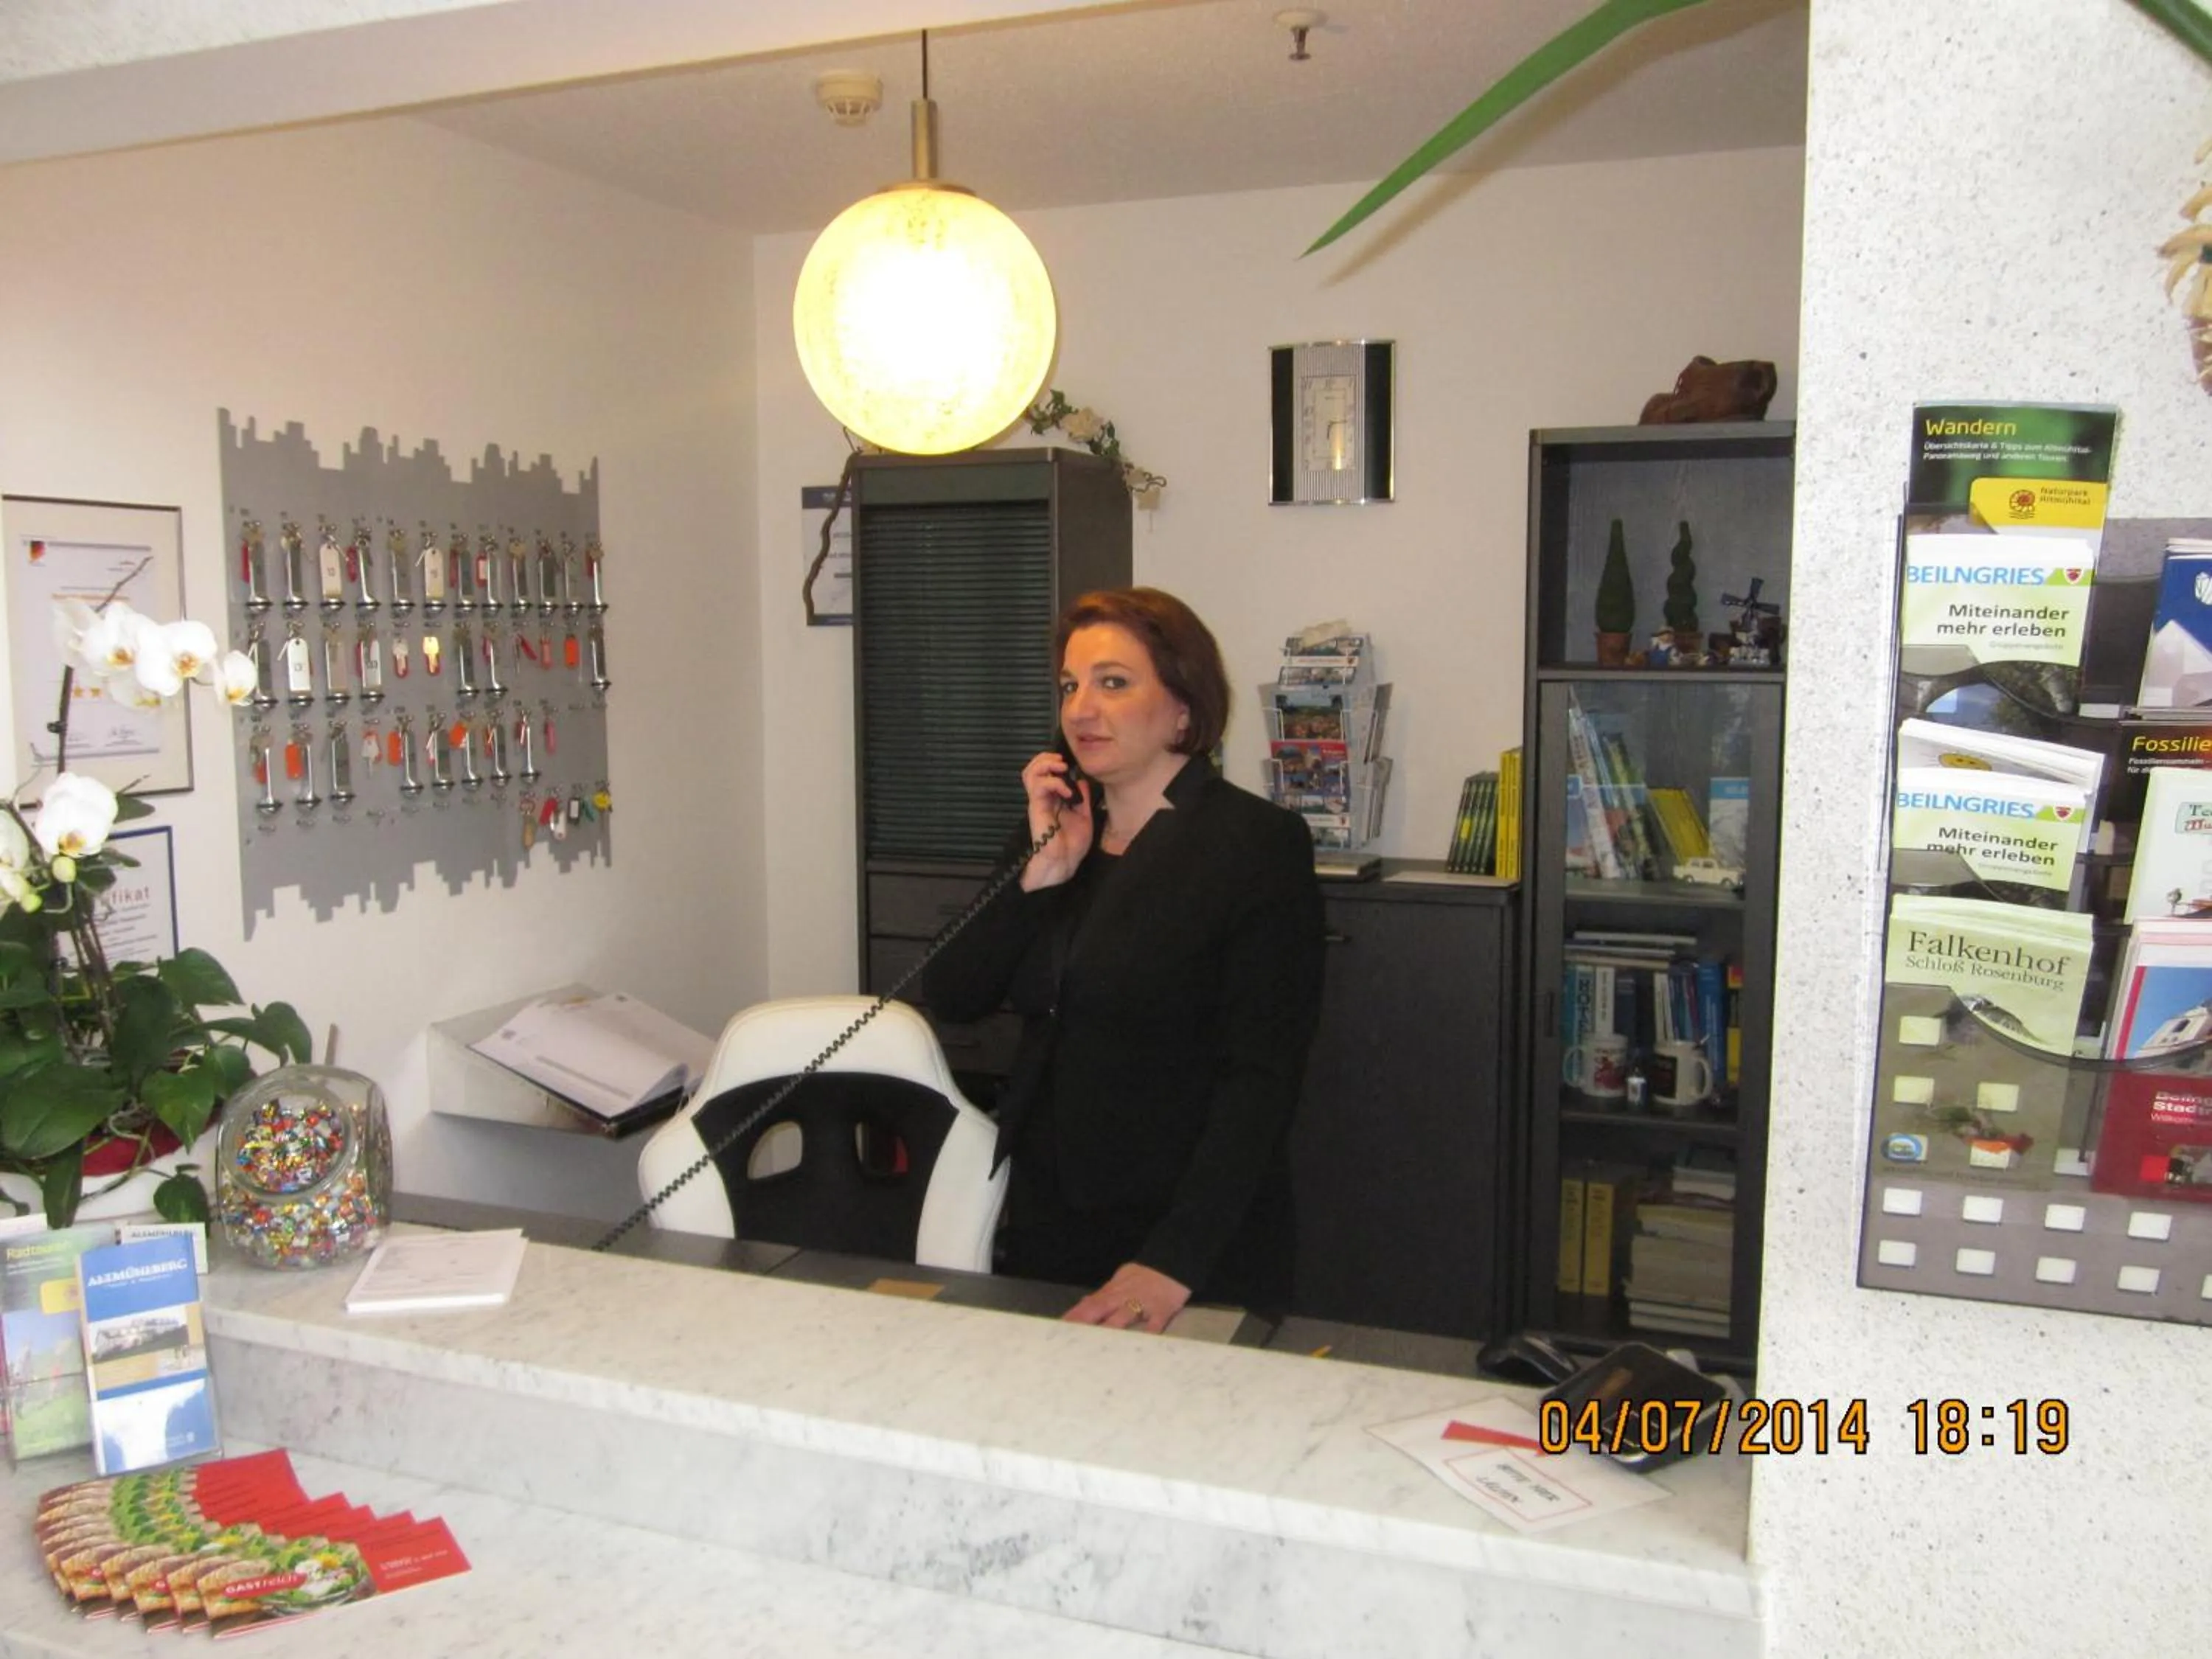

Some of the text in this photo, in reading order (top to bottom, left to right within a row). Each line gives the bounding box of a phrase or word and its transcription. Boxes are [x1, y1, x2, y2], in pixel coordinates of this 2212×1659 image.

[1925, 418, 2017, 436] Wandern
[1906, 566, 2044, 585] BEILNGRIES
[1949, 604, 2070, 620] Miteinander
[1937, 622, 2066, 638] mehr erleben
[1896, 793, 2035, 818] BEILNGRIES
[1938, 827, 2059, 851] Miteinander
[1927, 843, 2055, 866] mehr erleben
[1907, 931, 2071, 975] Falkenhof
[1905, 956, 2065, 992] Schloß Rosenburg
